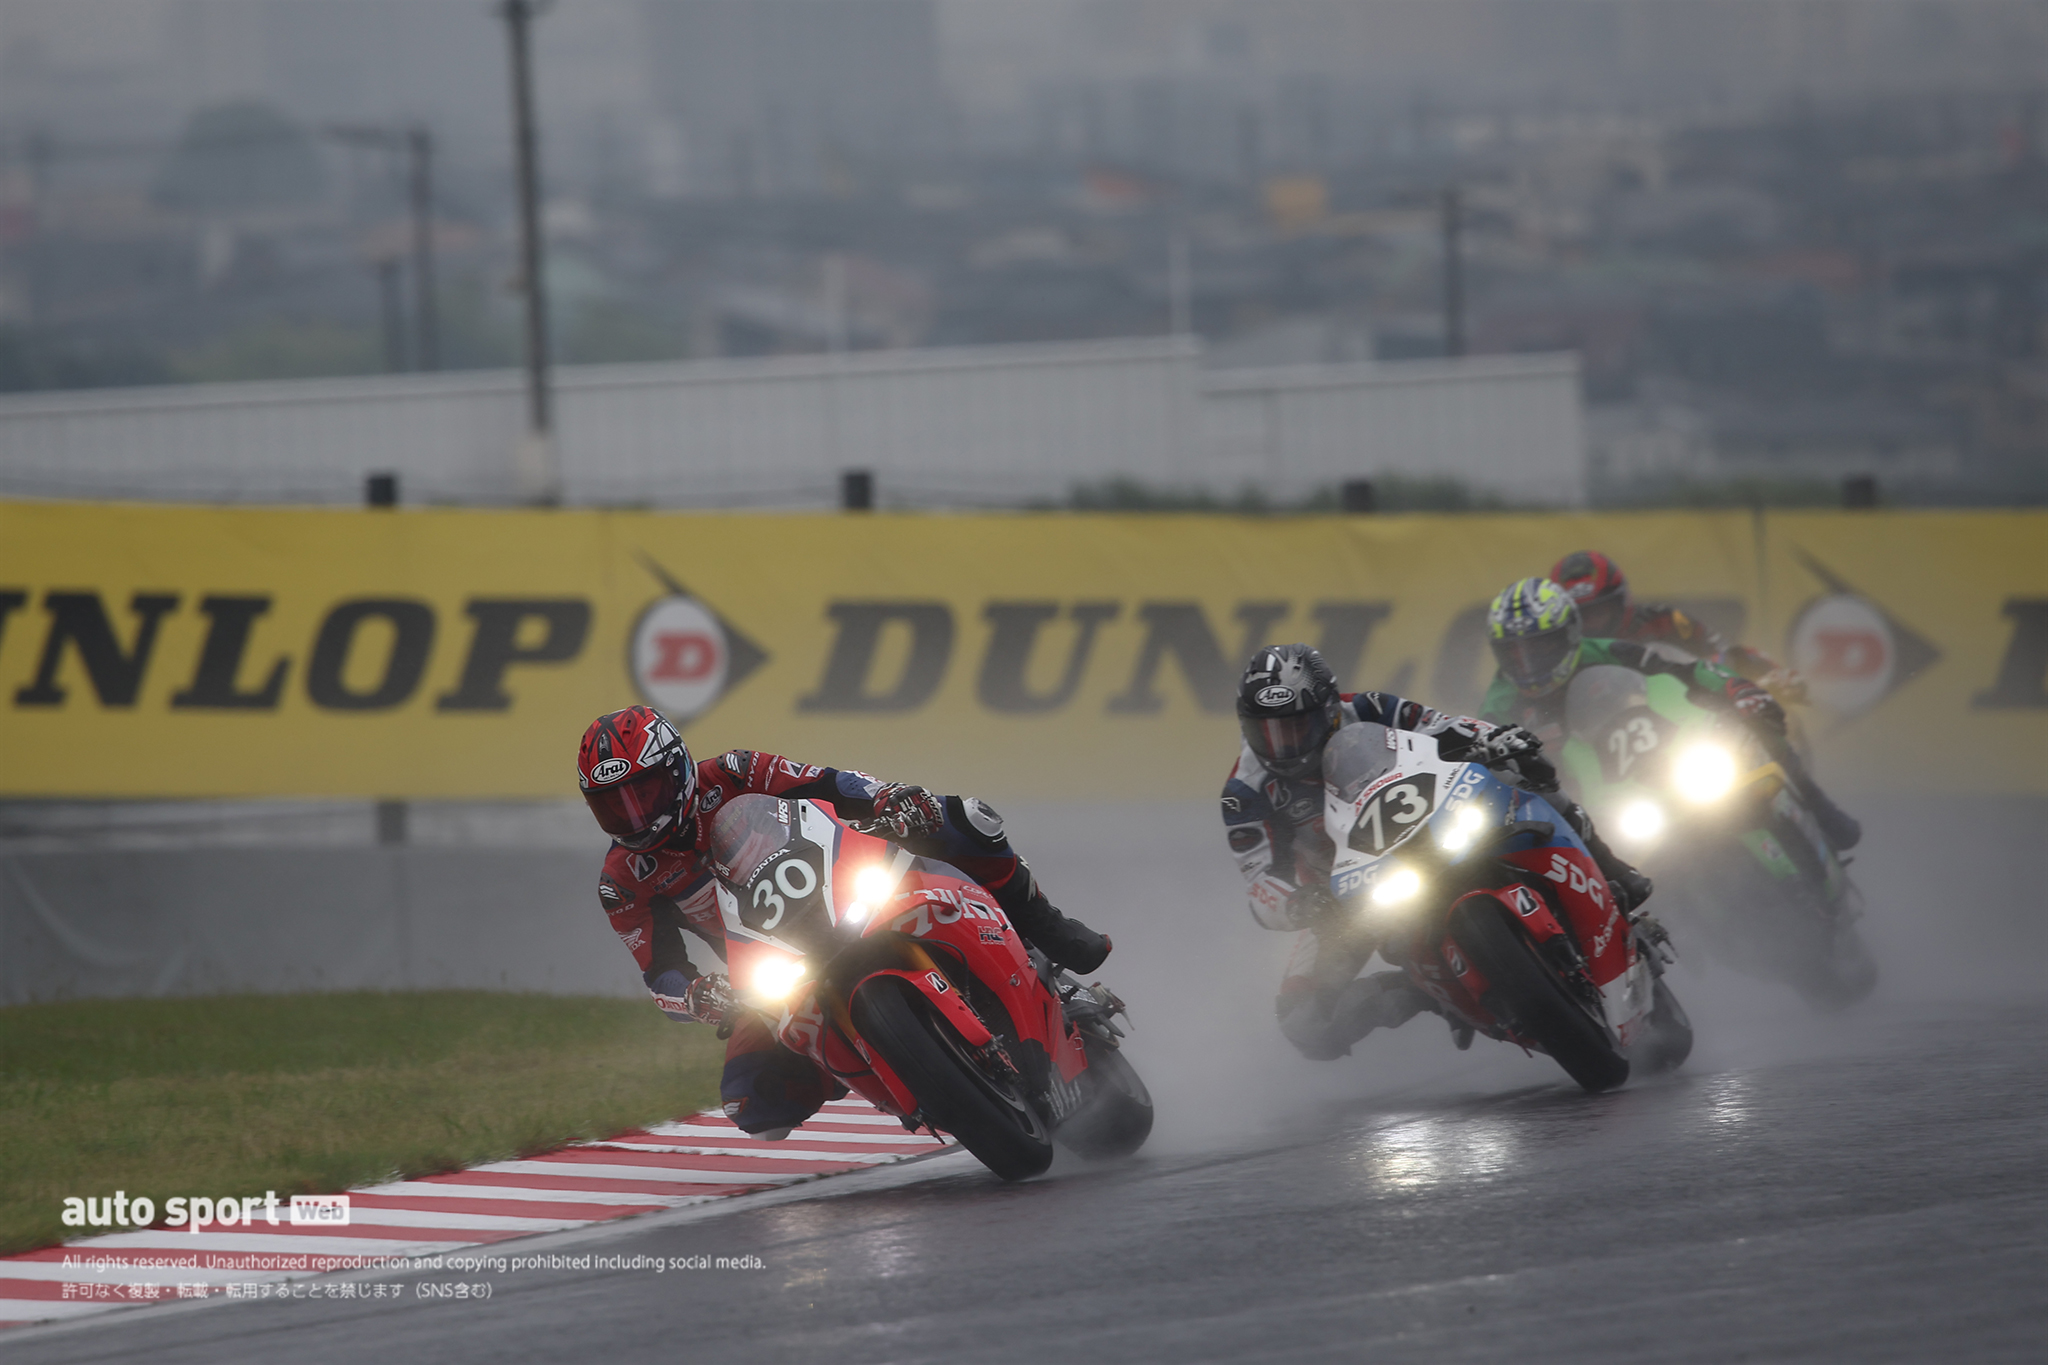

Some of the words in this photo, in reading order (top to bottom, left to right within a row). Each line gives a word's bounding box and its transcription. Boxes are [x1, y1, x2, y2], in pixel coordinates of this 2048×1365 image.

[0, 588, 594, 716] NLOP
[1608, 716, 1658, 775] 23
[595, 761, 625, 778] Arai
[779, 799, 789, 824] WRS
[746, 848, 791, 889] HONDA
[1338, 865, 1379, 896] SDG
[1544, 853, 1604, 910] SDG
[753, 858, 817, 930] 30
[653, 997, 687, 1012] ONDA
